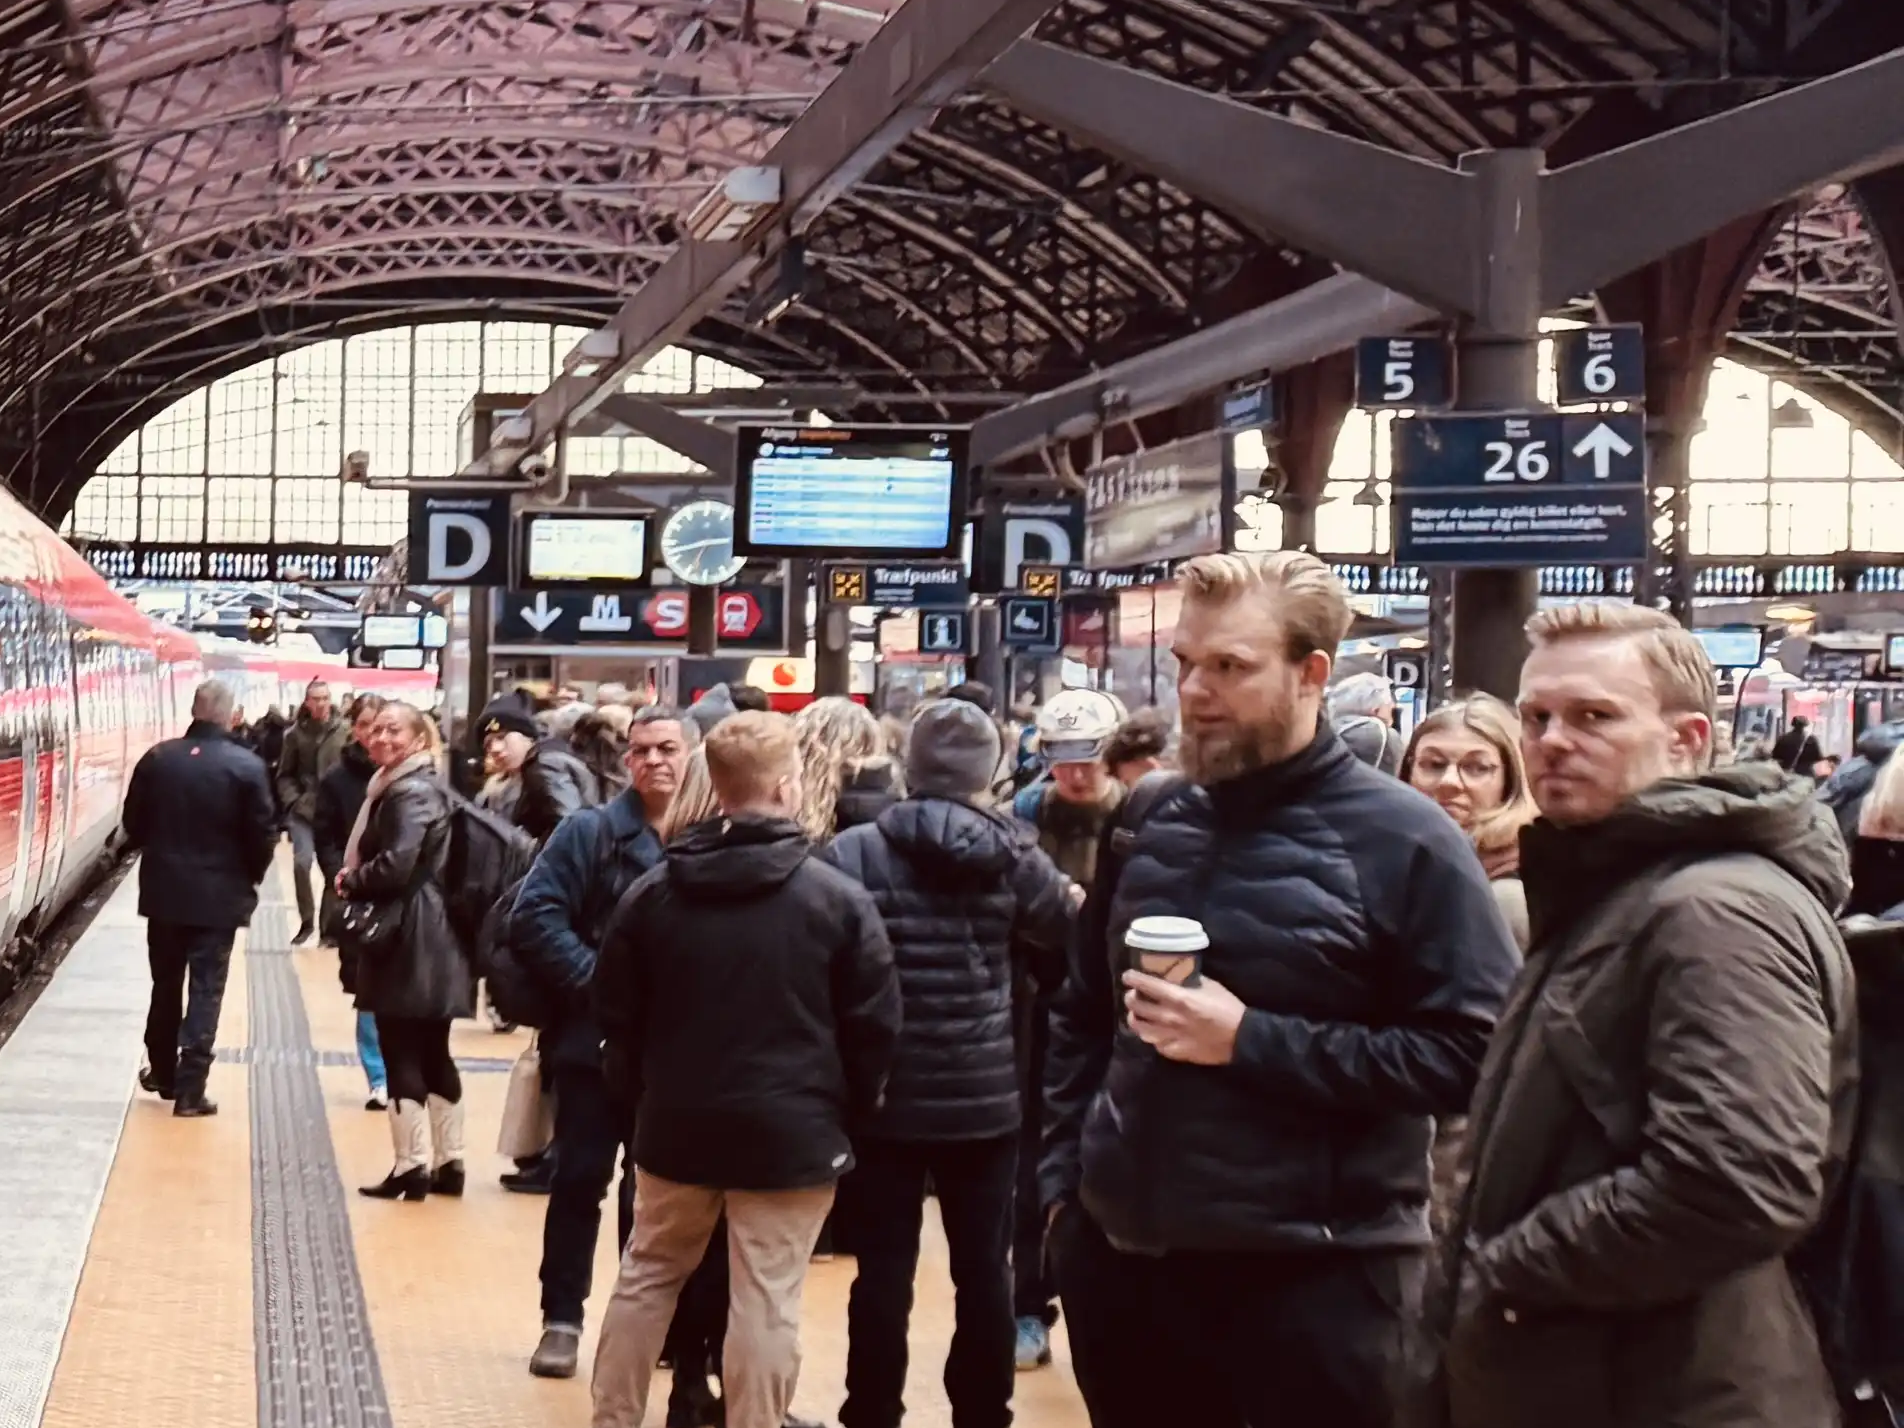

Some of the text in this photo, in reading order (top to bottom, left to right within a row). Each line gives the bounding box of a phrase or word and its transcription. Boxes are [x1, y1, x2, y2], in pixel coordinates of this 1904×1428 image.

[1383, 361, 1414, 401] 5
[1583, 353, 1616, 393] 6
[1484, 441, 1549, 482] 26
[427, 512, 491, 581] D
[1004, 518, 1071, 589] D
[874, 568, 958, 586] Træfpunkt
[654, 599, 686, 629] S
[1394, 661, 1419, 686] D
